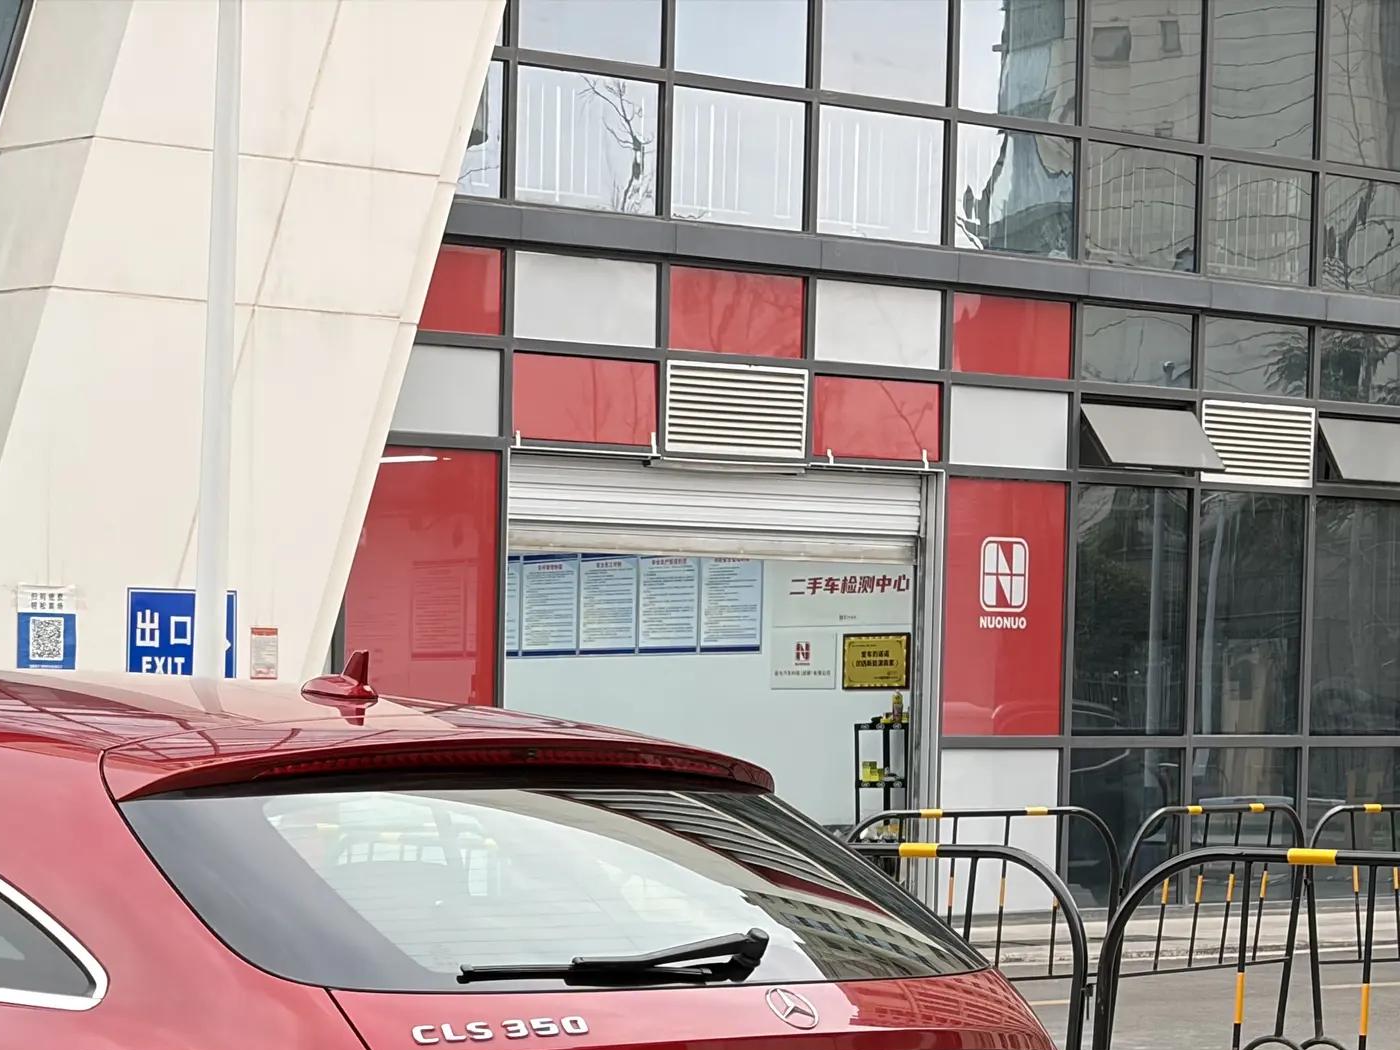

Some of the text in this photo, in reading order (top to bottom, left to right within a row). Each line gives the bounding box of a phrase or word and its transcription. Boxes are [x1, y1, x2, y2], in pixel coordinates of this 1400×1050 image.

[789, 574, 910, 596] 二手车检测中心
[135, 608, 192, 649] 出口
[979, 616, 1027, 629] NUONUO
[141, 656, 186, 676] EXIT
[411, 1015, 589, 1045] CLS 350
